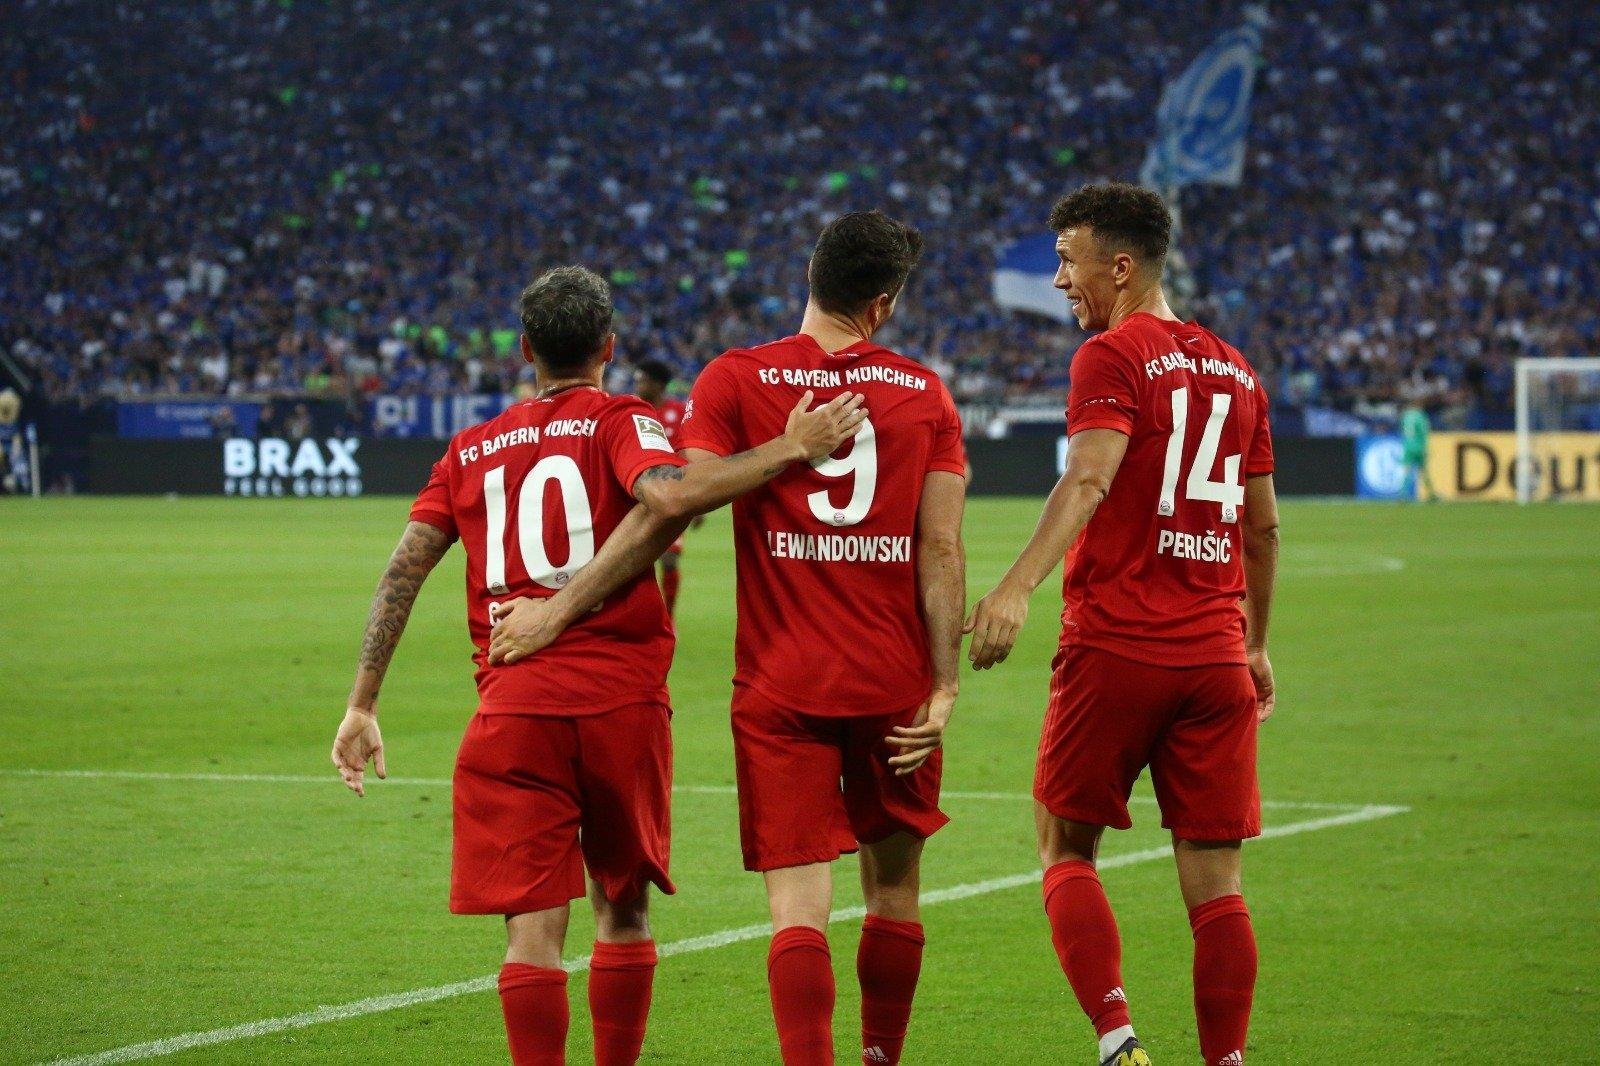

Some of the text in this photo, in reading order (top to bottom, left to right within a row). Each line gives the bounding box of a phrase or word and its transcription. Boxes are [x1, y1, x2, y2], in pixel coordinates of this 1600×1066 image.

[759, 365, 927, 391] FC BAYERN MÜNCHEN
[1145, 359, 1163, 380] FC
[223, 437, 361, 477] BRAX
[459, 417, 598, 467] FC BAYERN ÜNCEN
[1157, 386, 1245, 524] 14
[807, 403, 878, 527] 9
[1456, 443, 1600, 495] Deu
[484, 454, 595, 595] 10
[767, 530, 911, 563] LEWANDOWSKI
[1157, 529, 1232, 564] PERIŠIĆ
